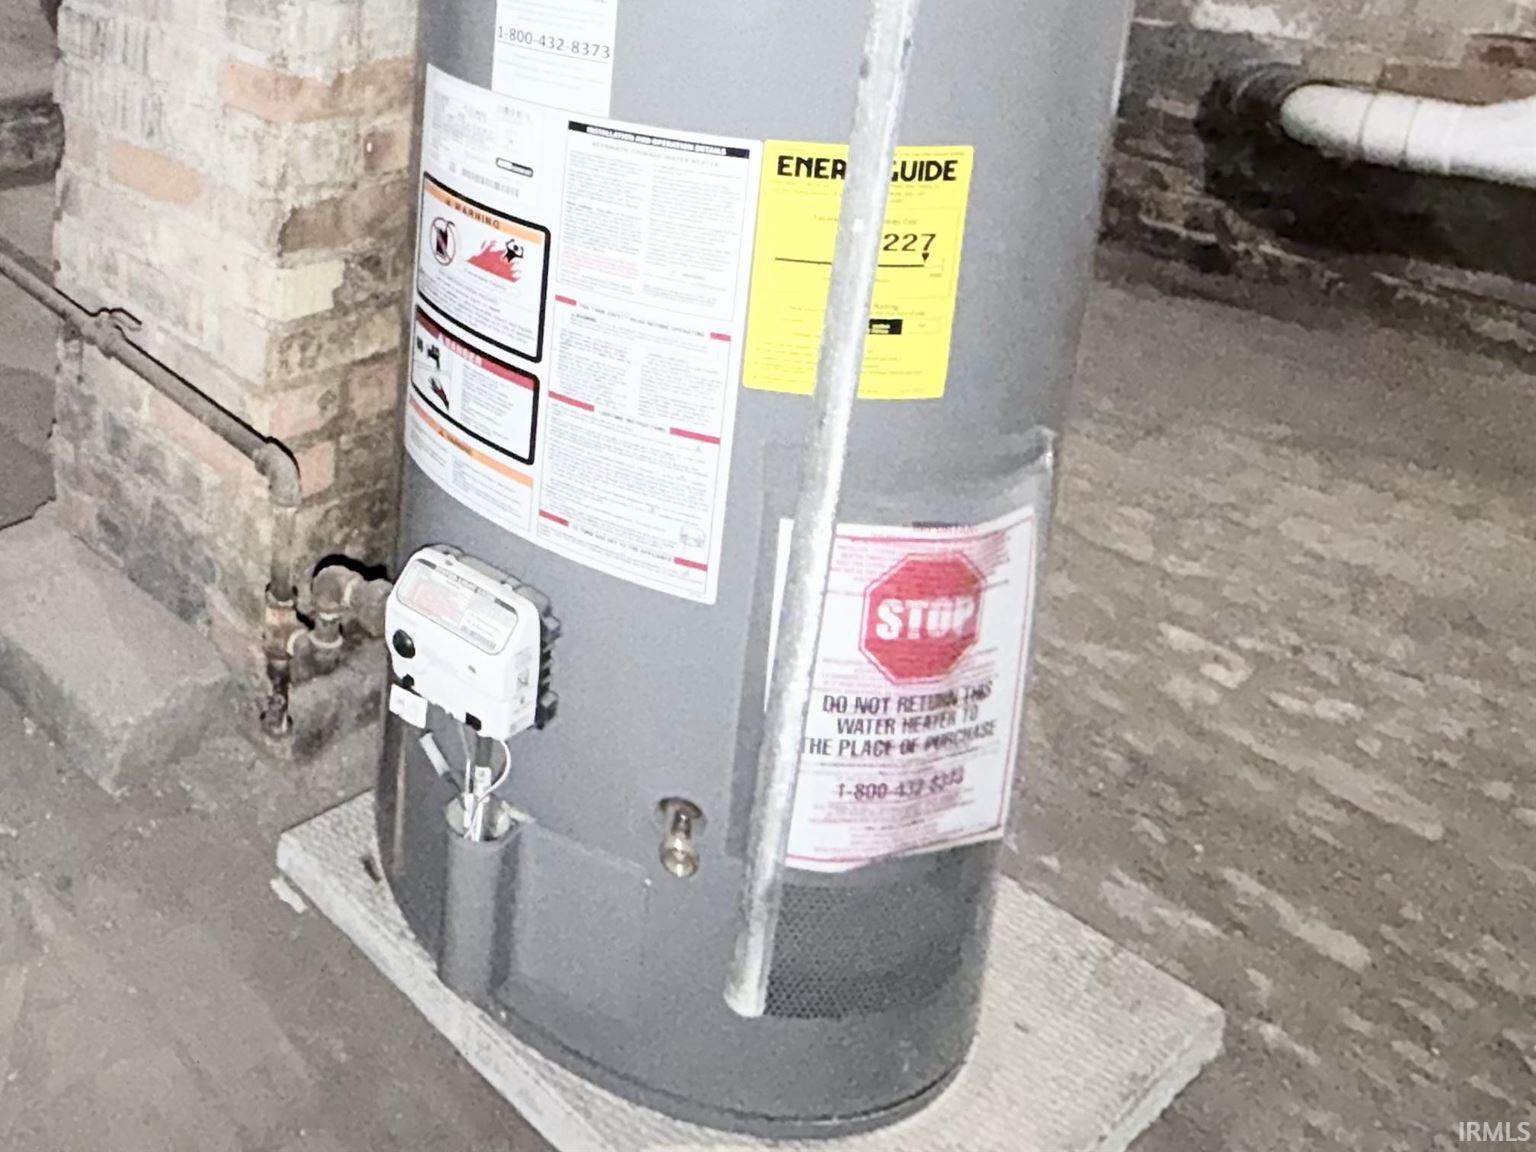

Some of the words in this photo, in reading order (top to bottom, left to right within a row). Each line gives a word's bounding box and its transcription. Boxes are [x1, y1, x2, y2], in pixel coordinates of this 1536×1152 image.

[497, 26, 611, 59] 1-800-432-8373
[882, 233, 937, 252] 227
[875, 595, 975, 641] STOP
[822, 695, 848, 714] DO
[854, 695, 891, 715] NOT
[896, 691, 958, 714] RETURN
[837, 718, 895, 736] WATER
[902, 710, 957, 733] HEATER
[963, 704, 979, 722] TO
[801, 736, 831, 756] THE
[838, 737, 894, 757] PLACE
[899, 738, 917, 755] OF
[924, 719, 998, 751] PURCHASE
